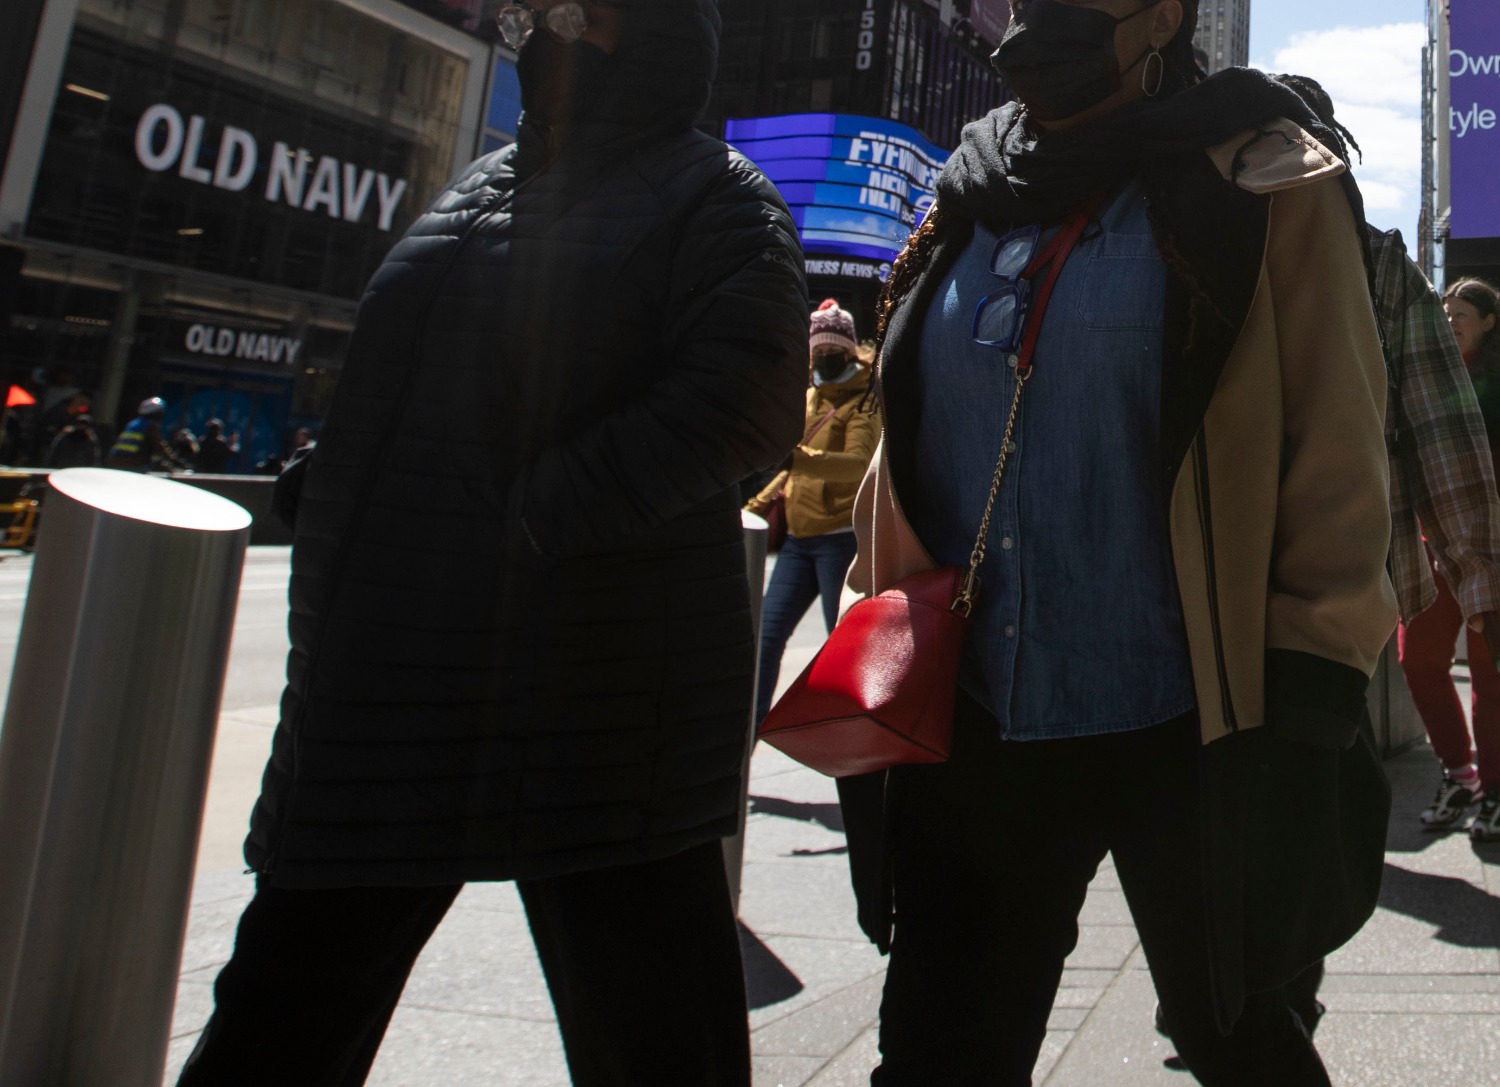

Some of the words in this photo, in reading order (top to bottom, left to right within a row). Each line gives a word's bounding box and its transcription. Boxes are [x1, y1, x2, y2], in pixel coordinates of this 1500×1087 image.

[135, 103, 258, 192] OLD
[265, 141, 407, 231] NAVY
[841, 262, 873, 278] NEWS
[185, 324, 235, 356] OLD
[235, 332, 302, 365] NAVY
